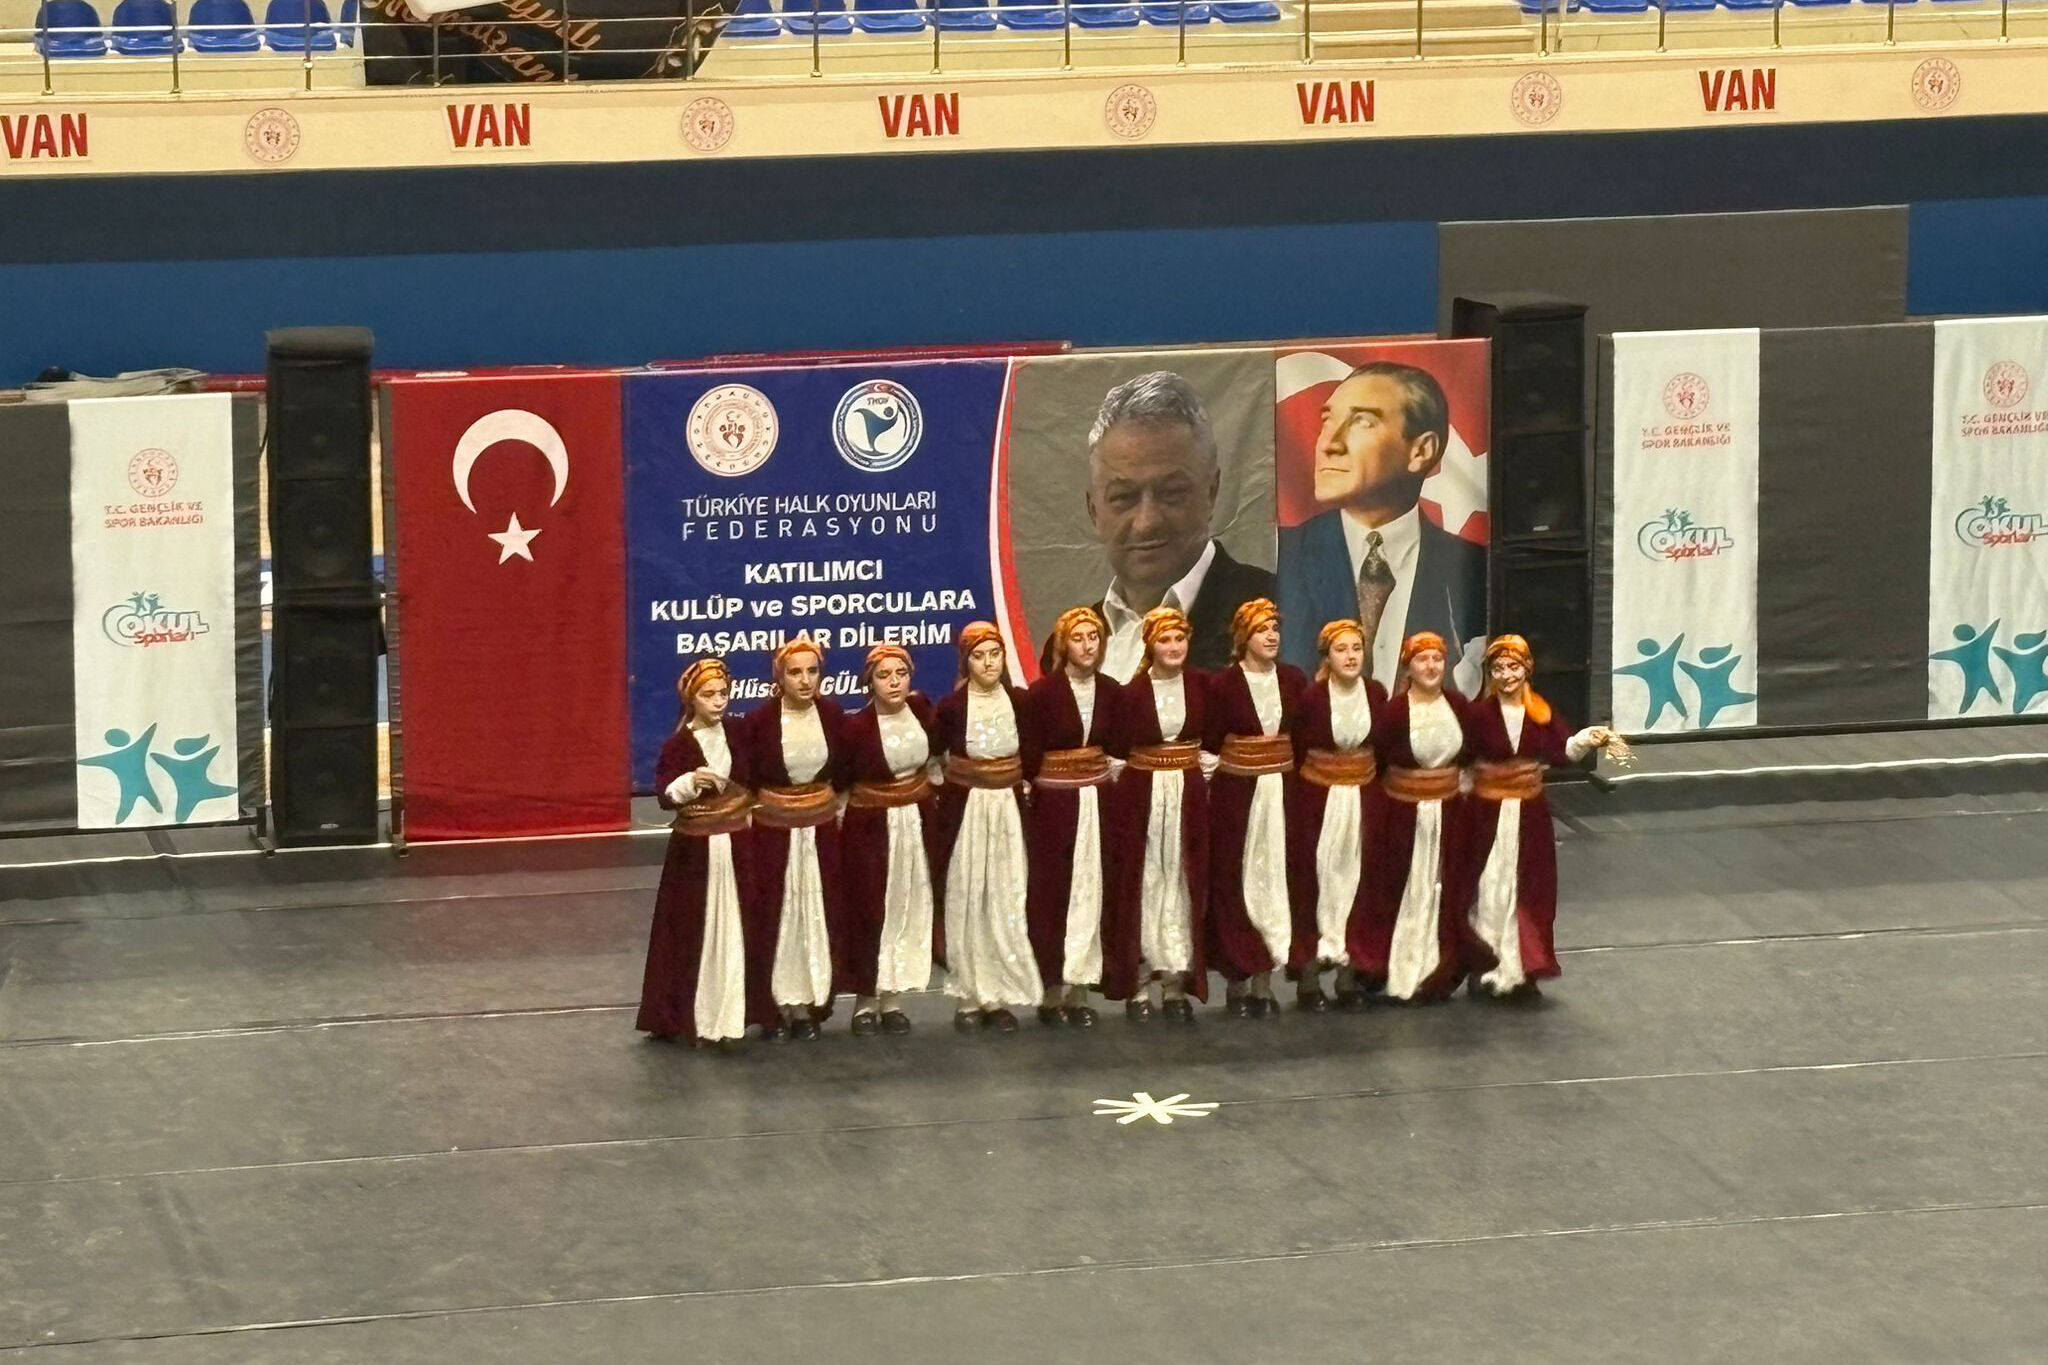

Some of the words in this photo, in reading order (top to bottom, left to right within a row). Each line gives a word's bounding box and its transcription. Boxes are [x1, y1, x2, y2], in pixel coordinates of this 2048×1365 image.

[1297, 81, 1375, 125] VAN
[1701, 68, 1776, 111] VAN
[447, 103, 531, 147] VAN
[878, 93, 959, 137] VAN
[0, 113, 88, 158] VAN
[682, 494, 769, 517] TÜRKİYE
[775, 495, 831, 514] HALK
[835, 490, 937, 513] OYUNLARI
[682, 514, 937, 541] FEDERASYONU
[745, 559, 883, 584] KATILIMCI
[651, 594, 743, 621] KULÜP
[750, 600, 783, 618] ve
[791, 589, 976, 616] SPORCULARA
[839, 619, 951, 648] DİLERİM
